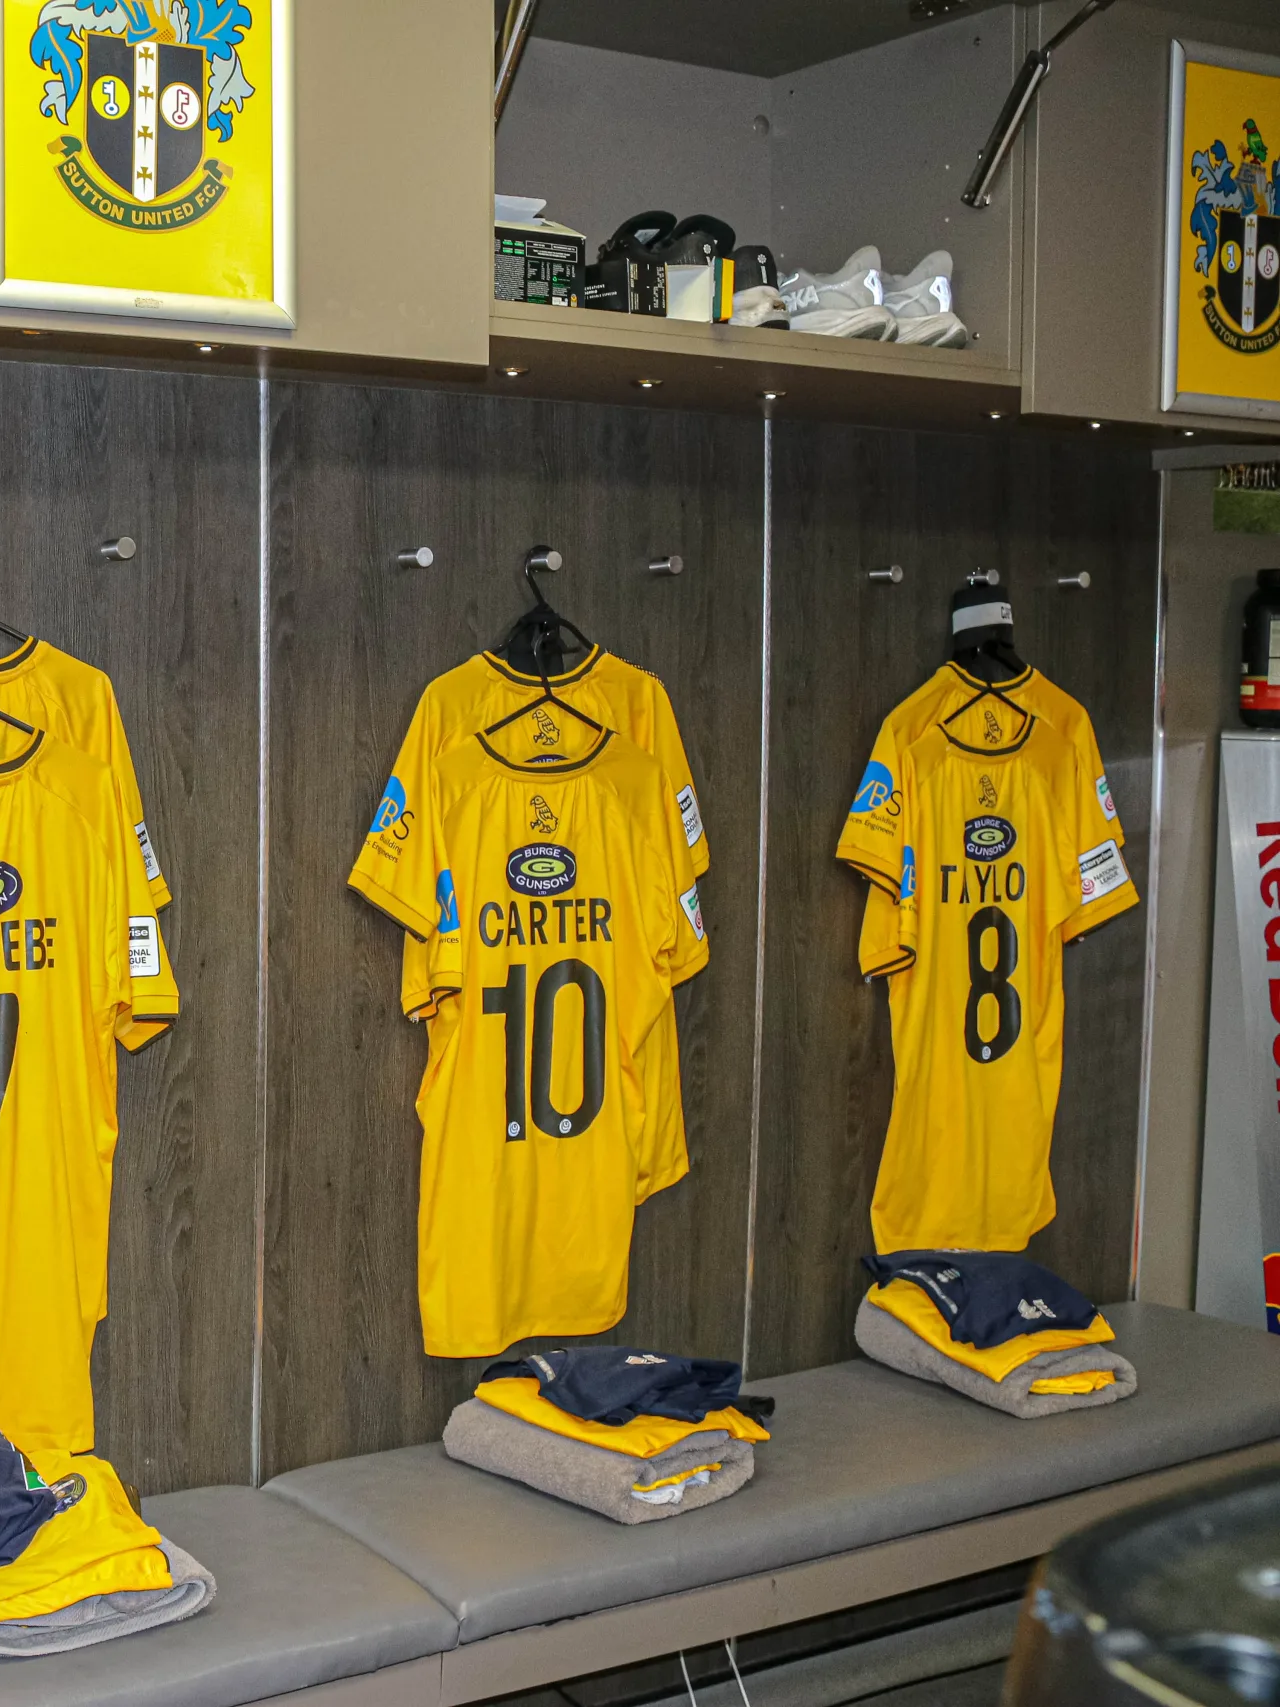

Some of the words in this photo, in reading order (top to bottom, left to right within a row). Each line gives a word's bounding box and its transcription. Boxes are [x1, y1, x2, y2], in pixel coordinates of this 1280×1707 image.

[63, 162, 125, 221] SUTTON
[131, 203, 194, 225] UNITED
[195, 184, 219, 208] F.C.
[1205, 304, 1238, 347] SUTTON
[1240, 333, 1274, 350] UNITED
[974, 818, 1001, 829] BURGE
[379, 833, 403, 856] Building
[977, 831, 996, 842] G
[524, 847, 561, 859] BURGE
[966, 841, 1006, 856] GUNSON
[527, 860, 556, 874] G
[516, 874, 570, 890] GUNSON
[478, 898, 613, 948] CARTER
[964, 905, 1022, 1065] 8
[481, 958, 607, 1144] 10
